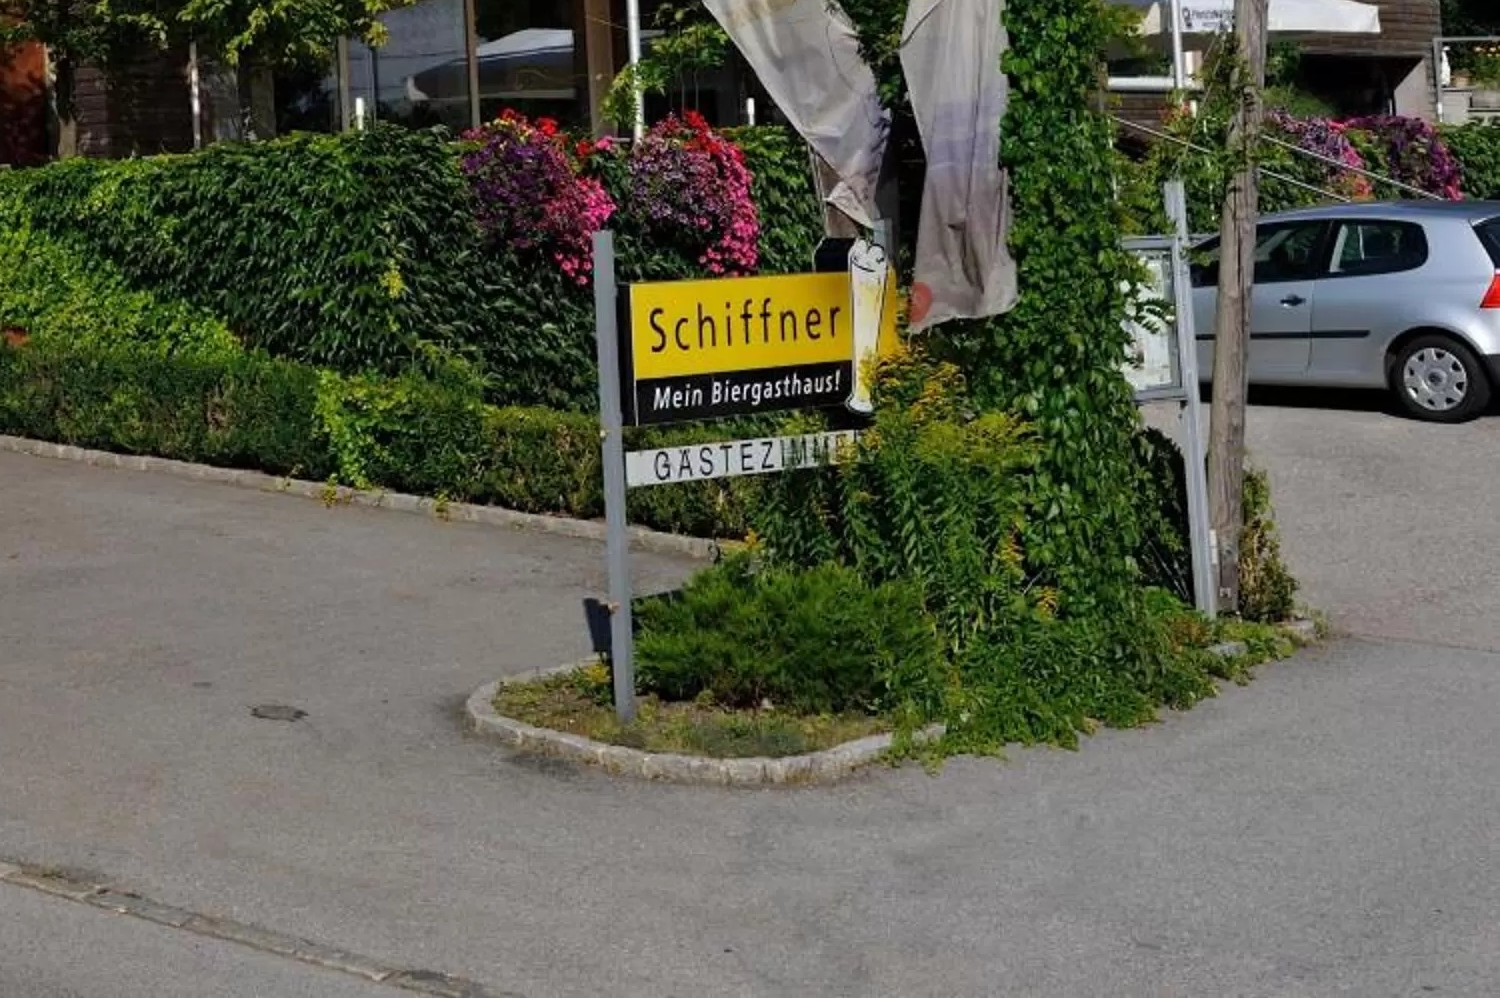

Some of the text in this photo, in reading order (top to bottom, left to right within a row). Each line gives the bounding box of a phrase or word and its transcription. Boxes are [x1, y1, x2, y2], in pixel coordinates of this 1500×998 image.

[650, 297, 841, 353] Schiffner
[653, 369, 841, 411] Mein Biergasthaus!
